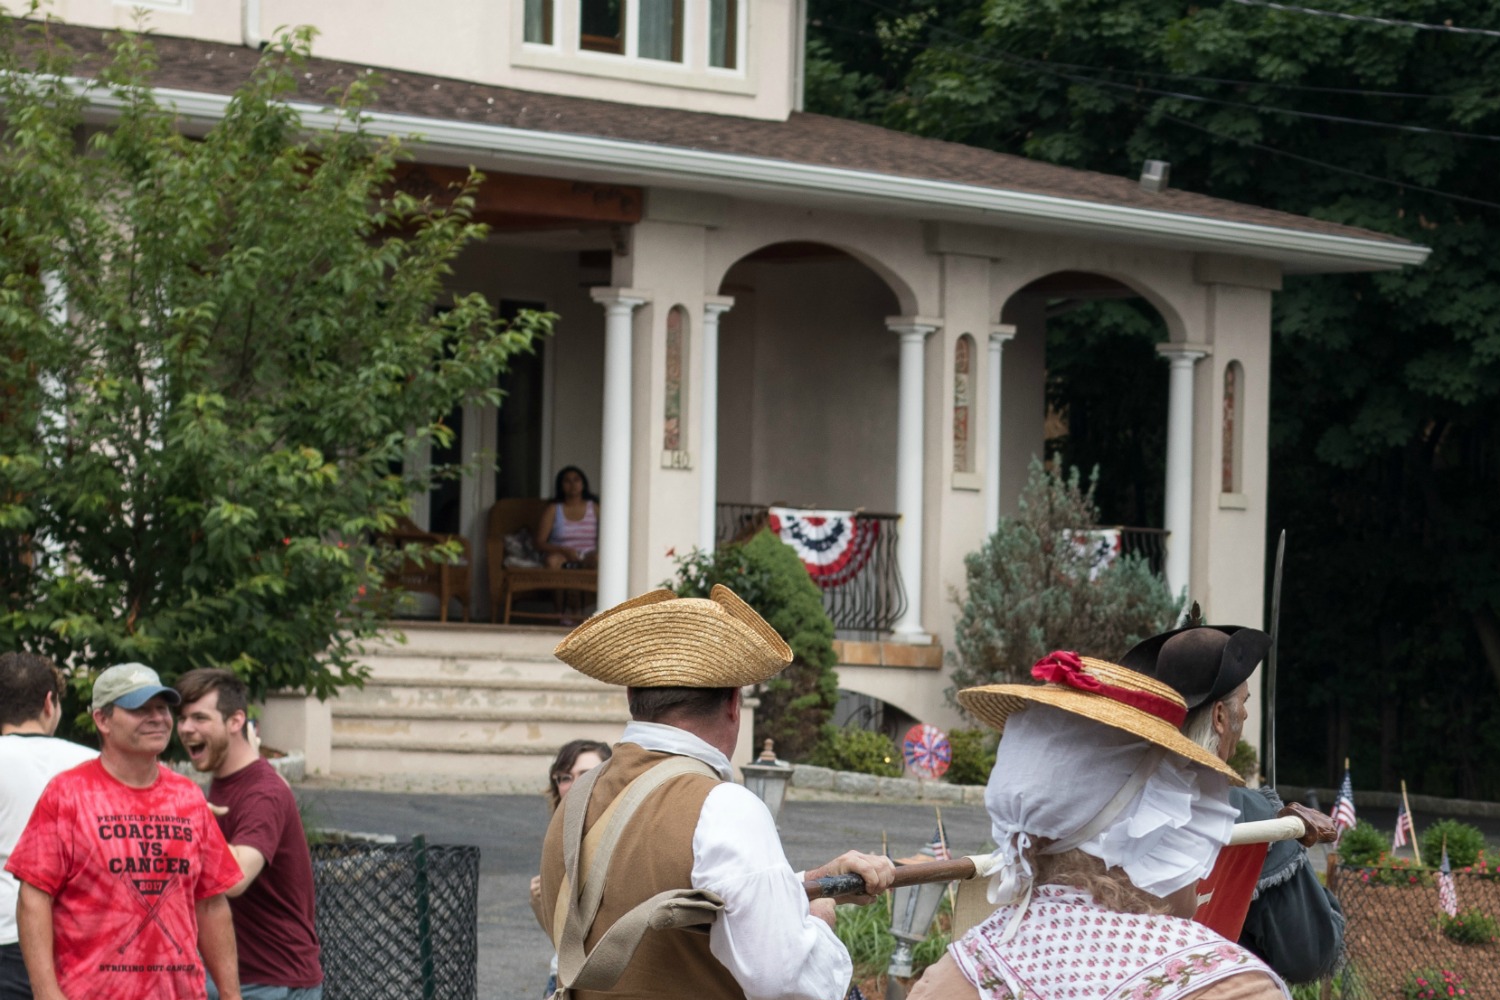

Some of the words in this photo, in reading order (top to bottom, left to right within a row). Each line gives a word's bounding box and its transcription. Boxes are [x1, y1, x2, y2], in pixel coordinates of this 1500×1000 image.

[98, 823, 193, 842] COACHES
[138, 841, 168, 857] VS.
[108, 857, 190, 875] CANCER
[139, 881, 163, 891] 2017
[99, 964, 144, 972] STRIKING
[147, 964, 164, 972] OUT
